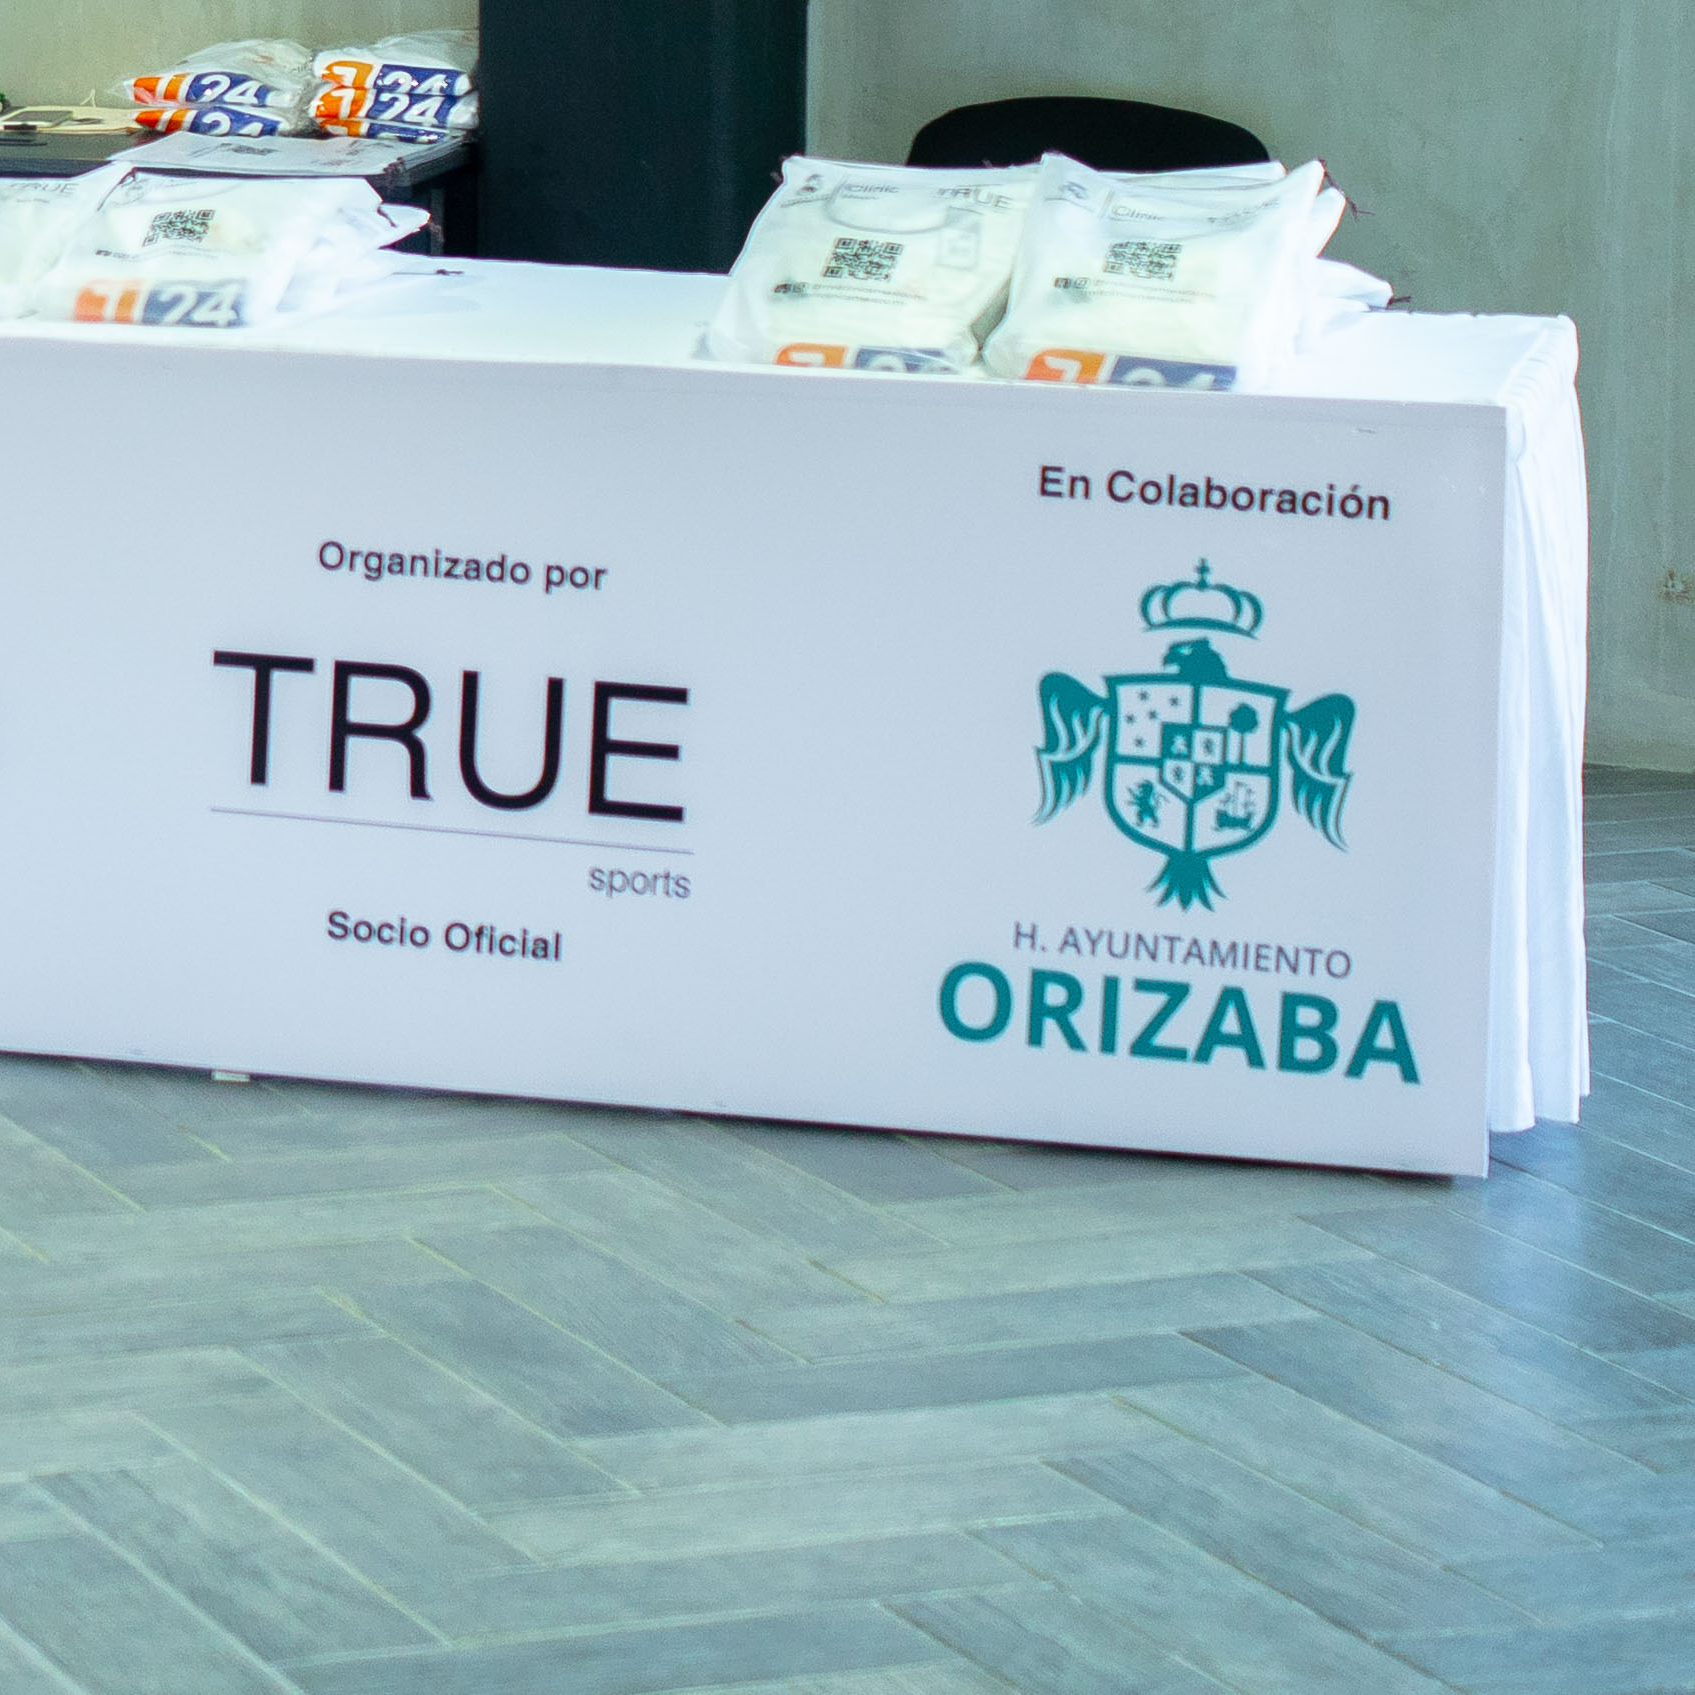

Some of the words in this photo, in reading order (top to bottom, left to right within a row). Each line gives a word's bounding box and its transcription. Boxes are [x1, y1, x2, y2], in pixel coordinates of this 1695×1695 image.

[1038, 465, 1091, 500] En
[1107, 469, 1391, 521] Colaboración
[318, 540, 532, 585] Organizado
[545, 562, 608, 594] por
[213, 650, 689, 823] TRUE
[588, 867, 691, 899] sports
[327, 910, 431, 950] Socio
[444, 922, 563, 962] Oficial
[1012, 921, 1047, 953] H.
[1059, 927, 1352, 979] AYUNTAMIENTO
[938, 961, 1421, 1086] ORIZABA
